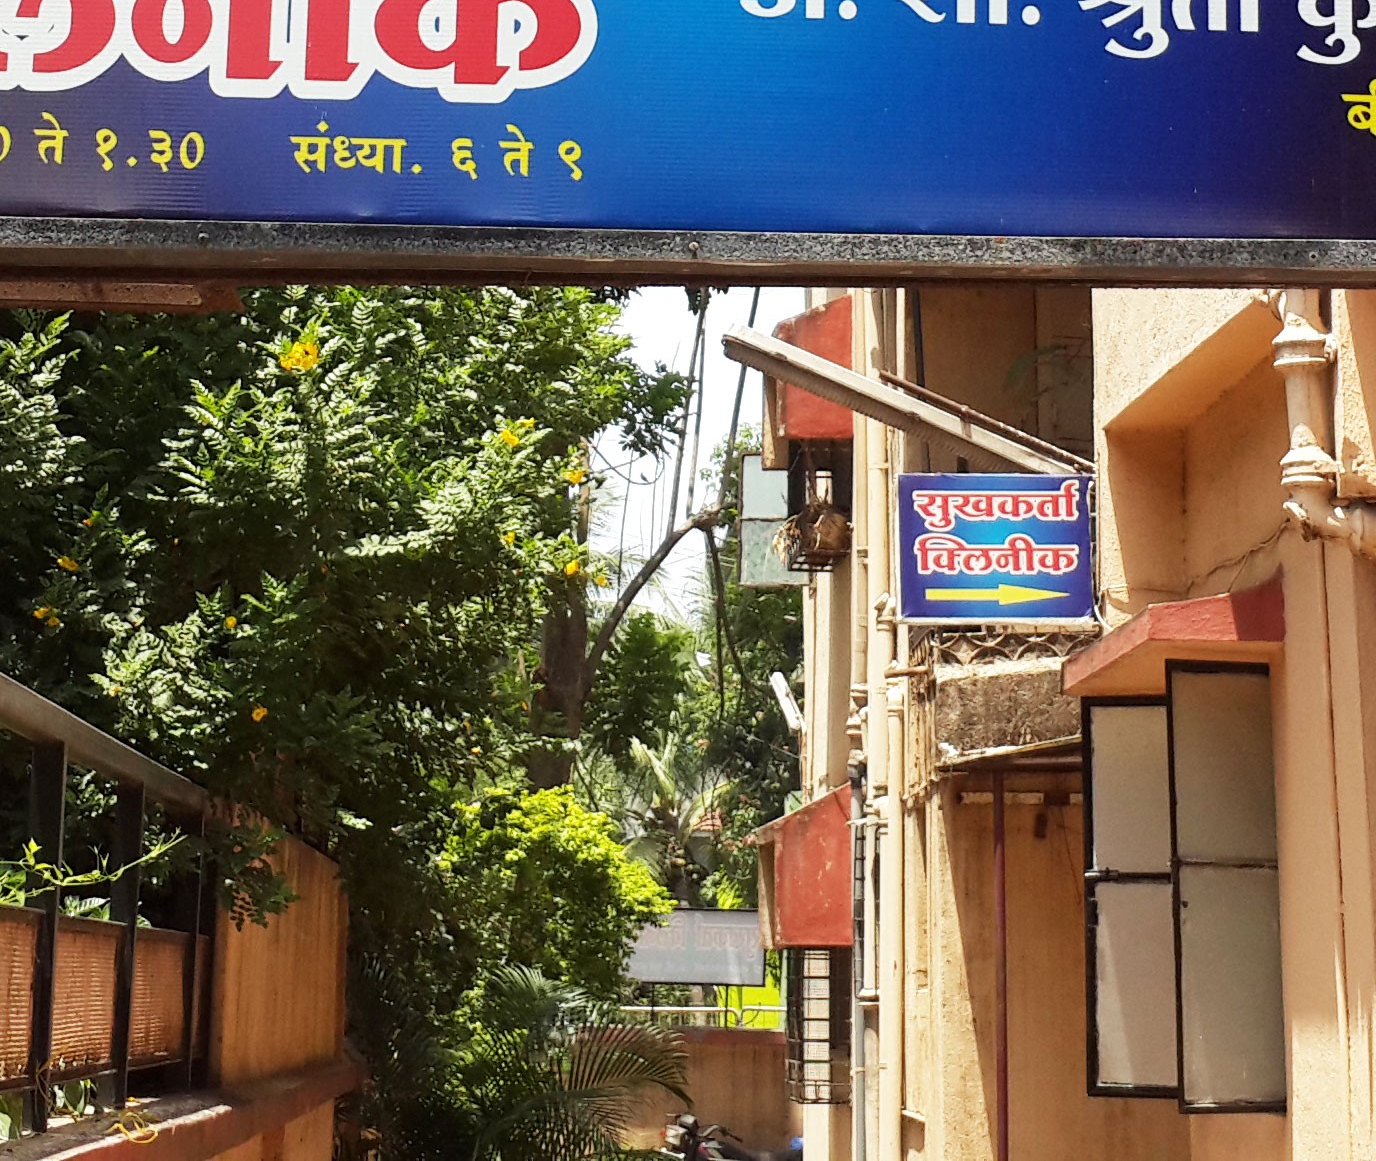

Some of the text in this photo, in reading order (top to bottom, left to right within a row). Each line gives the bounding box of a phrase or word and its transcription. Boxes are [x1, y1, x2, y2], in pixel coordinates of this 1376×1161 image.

[34, 112, 70, 162] ते
[94, 128, 206, 171] १.३०
[292, 121, 422, 174] संध्या.
[452, 137, 477, 177] ६
[500, 124, 533, 177] ते
[558, 140, 584, 179] ९
[914, 481, 1079, 531] सुखकर्ता
[915, 534, 1079, 574] क्लिनीक
